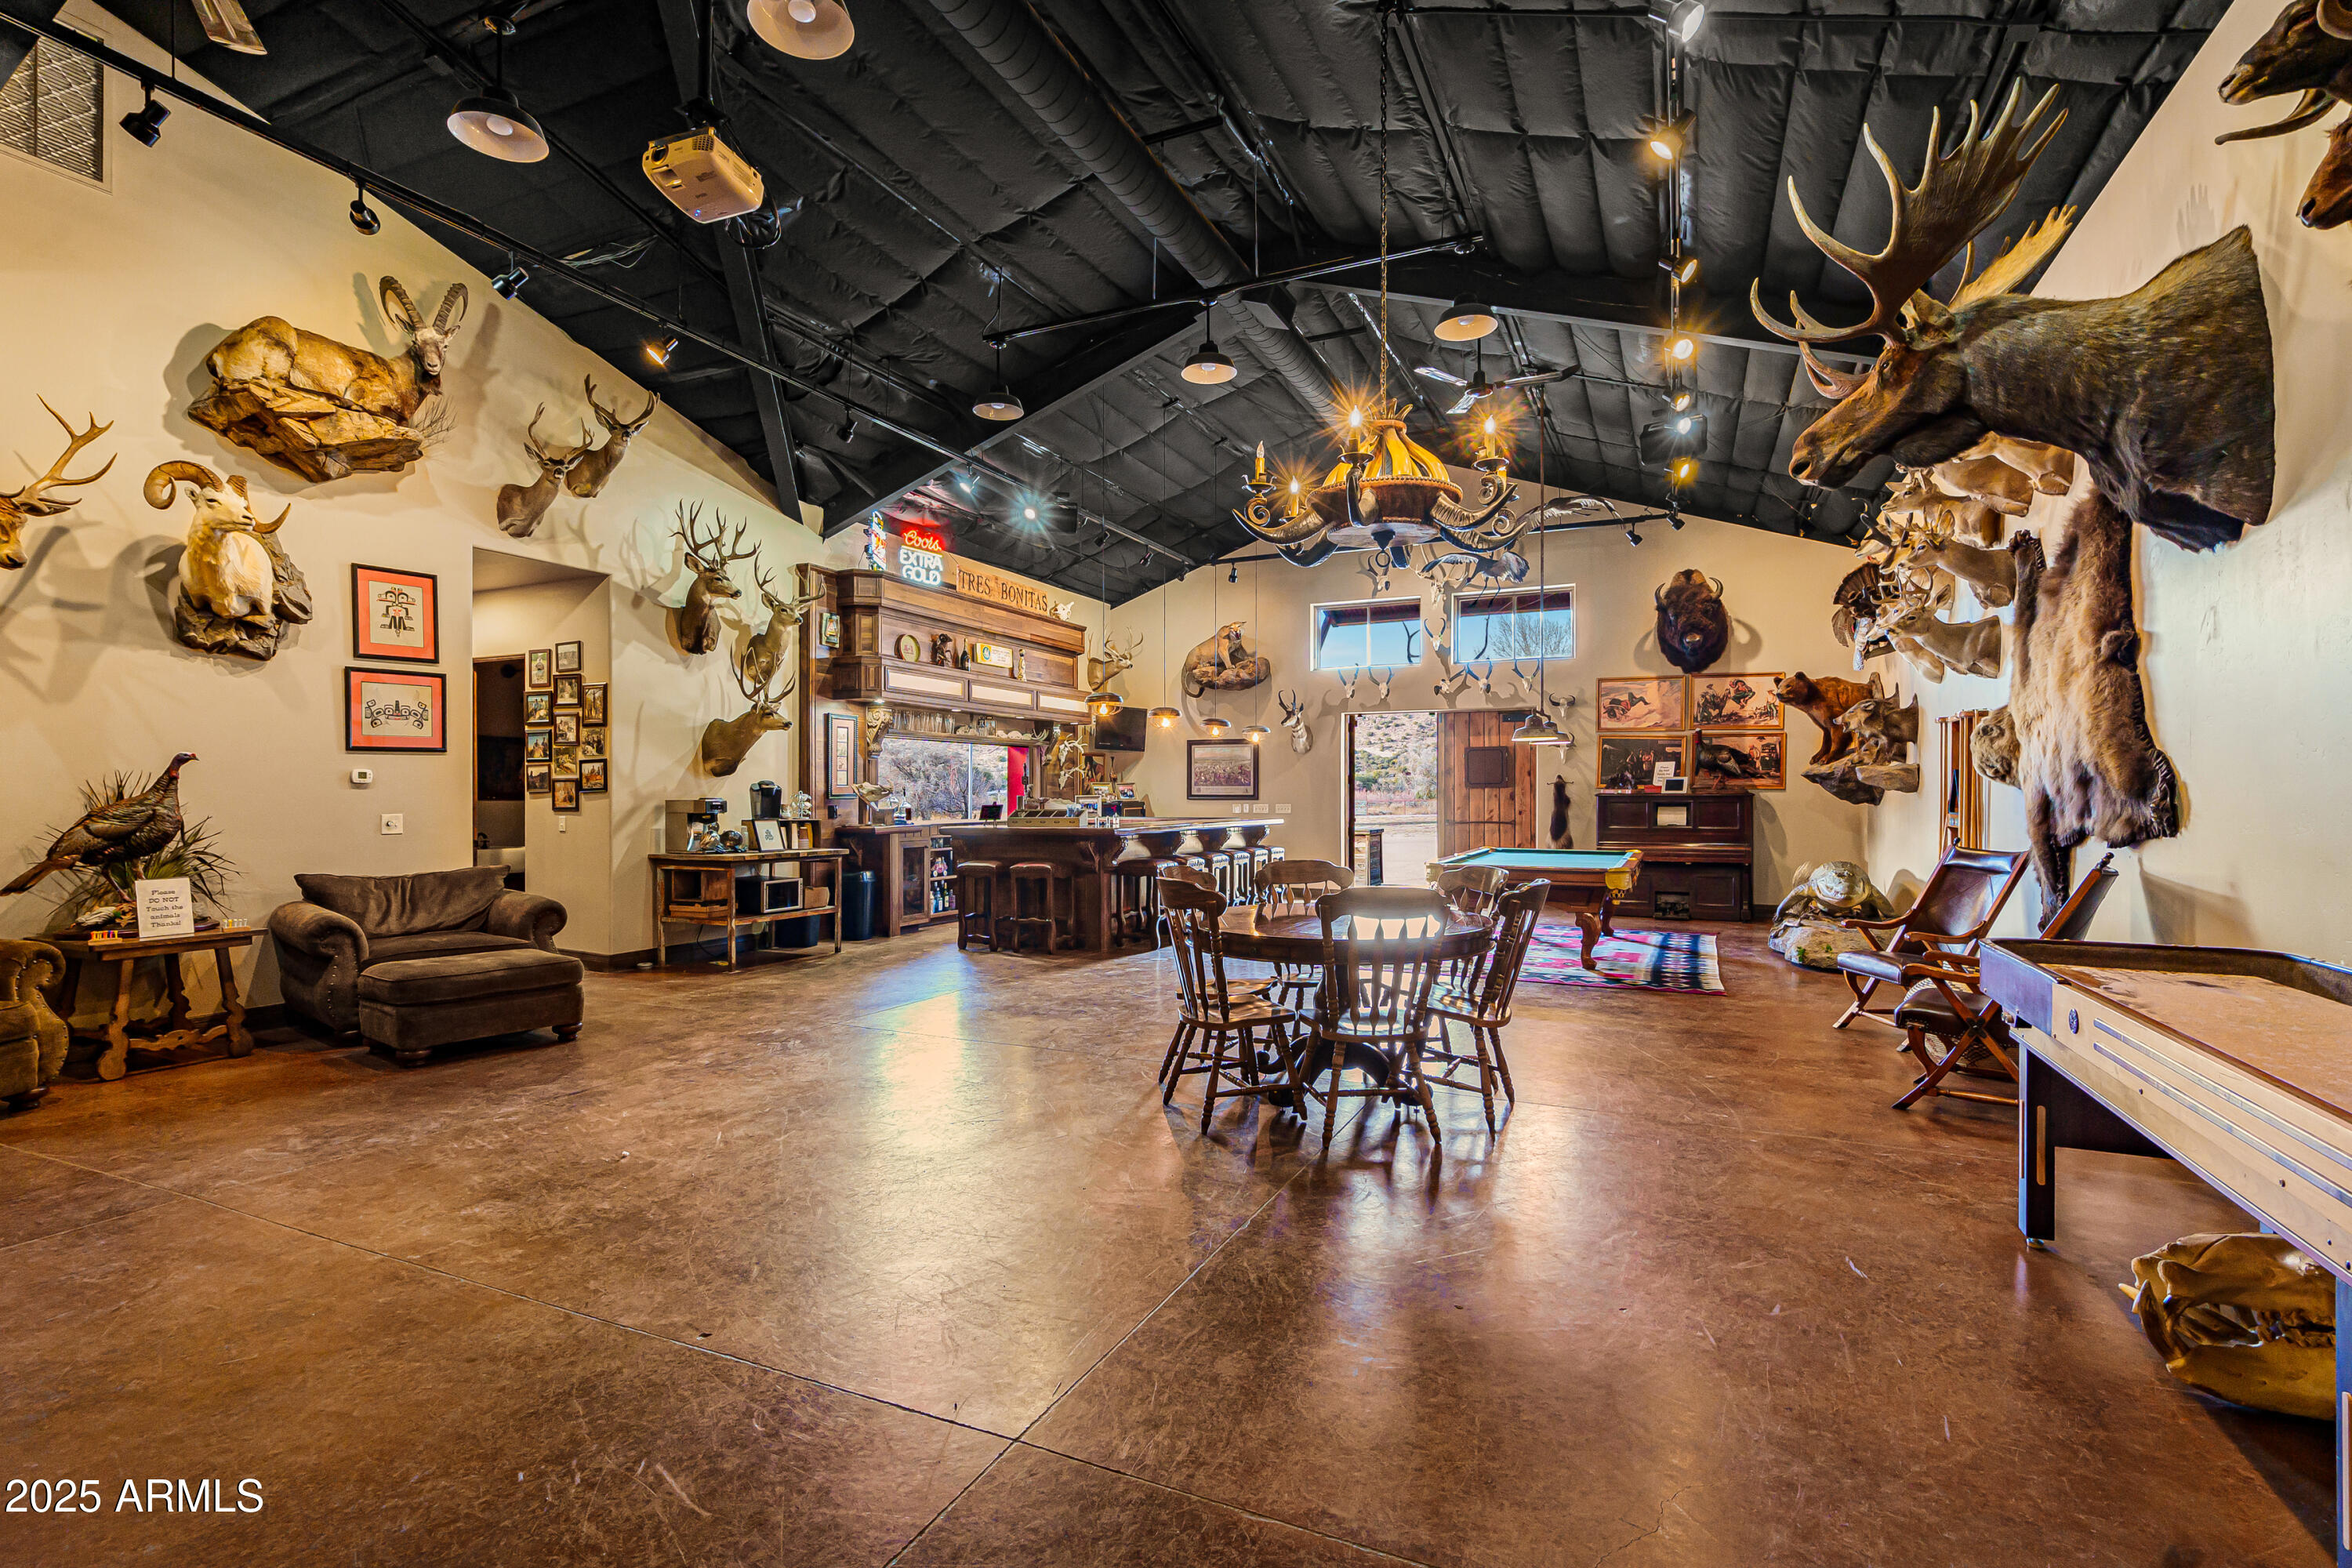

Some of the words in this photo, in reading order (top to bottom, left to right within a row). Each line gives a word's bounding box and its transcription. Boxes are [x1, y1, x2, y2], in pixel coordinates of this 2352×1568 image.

[903, 530, 942, 551] Coors
[899, 549, 943, 572] EXTRA
[902, 565, 941, 586] GOLD
[959, 570, 991, 595] TRES
[1001, 583, 1047, 612] BONITAS
